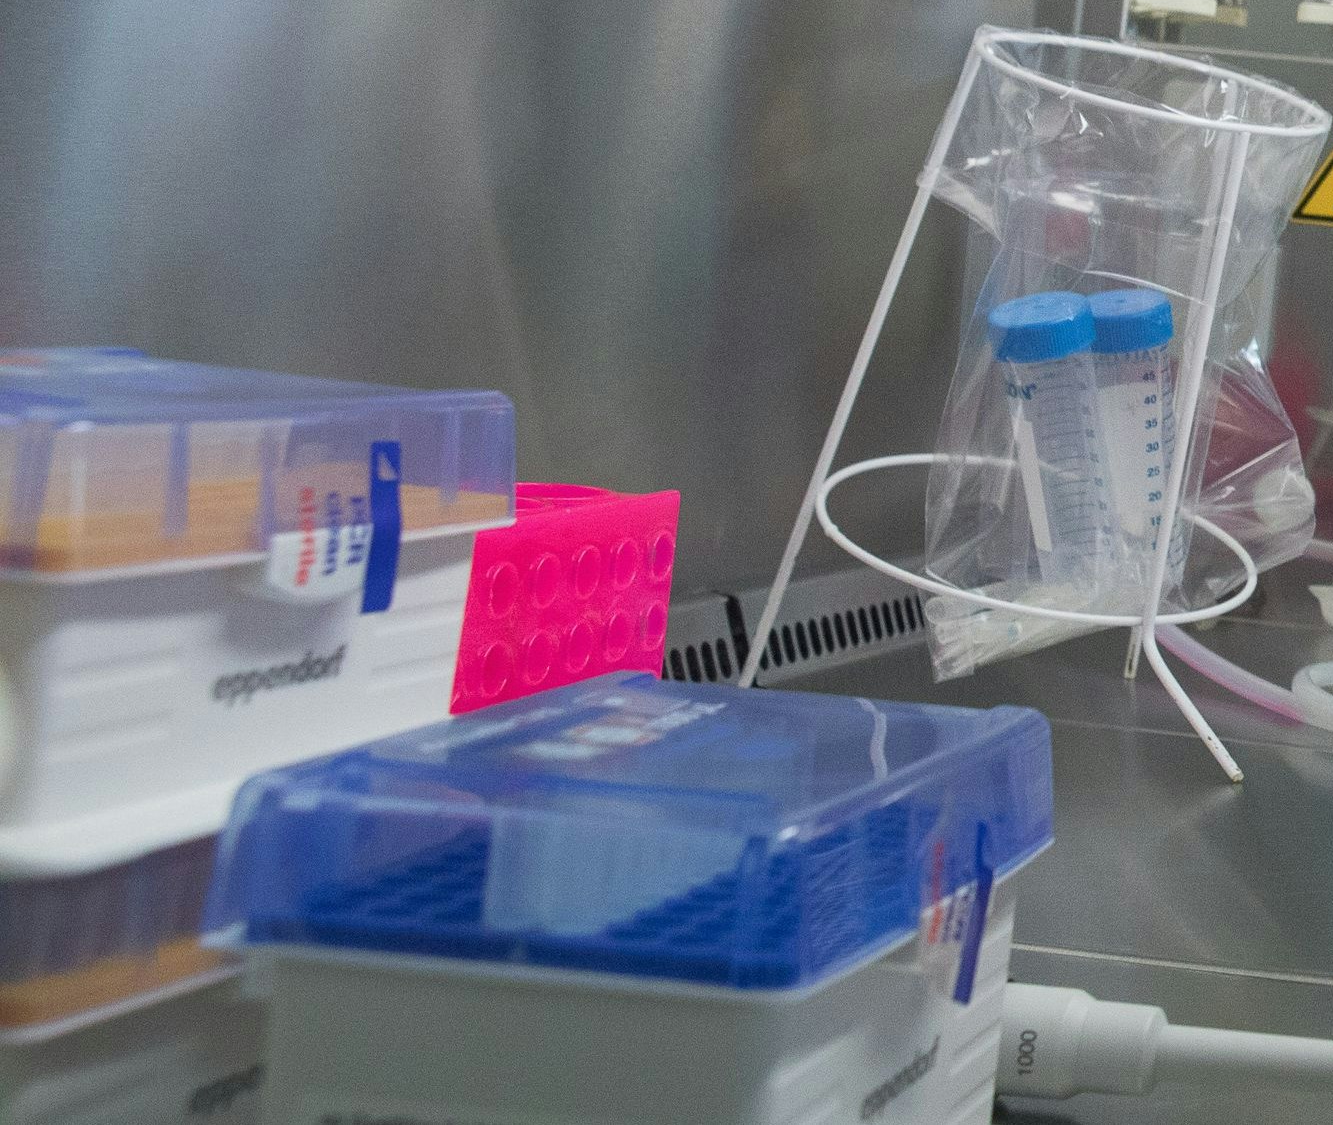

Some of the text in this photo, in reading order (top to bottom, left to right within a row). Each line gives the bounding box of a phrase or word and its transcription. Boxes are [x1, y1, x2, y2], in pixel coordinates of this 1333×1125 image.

[1144, 394, 1158, 405] 40
[1144, 418, 1159, 430] 35
[1145, 442, 1160, 454] 30
[1146, 466, 1161, 479] 25
[1148, 490, 1163, 502] 20
[1016, 1028, 1038, 1077] 1000
